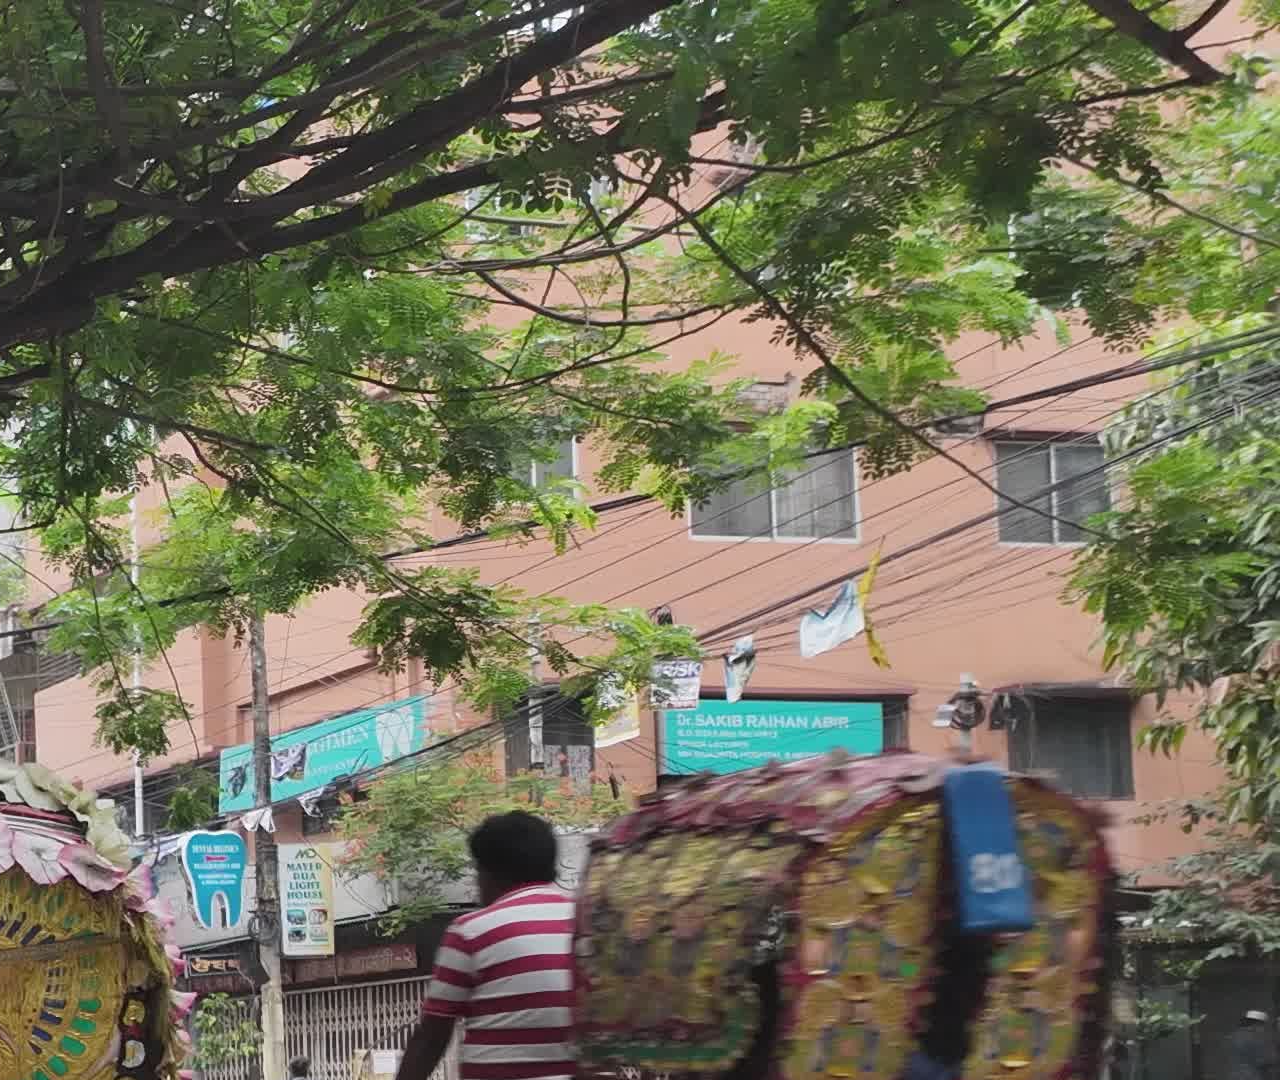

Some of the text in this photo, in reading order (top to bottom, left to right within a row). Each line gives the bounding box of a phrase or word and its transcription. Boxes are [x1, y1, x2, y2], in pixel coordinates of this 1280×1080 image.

[695, 714, 742, 728] SAKIB
[746, 715, 808, 729] RAIHAN
[289, 881, 321, 890] LIGHT
